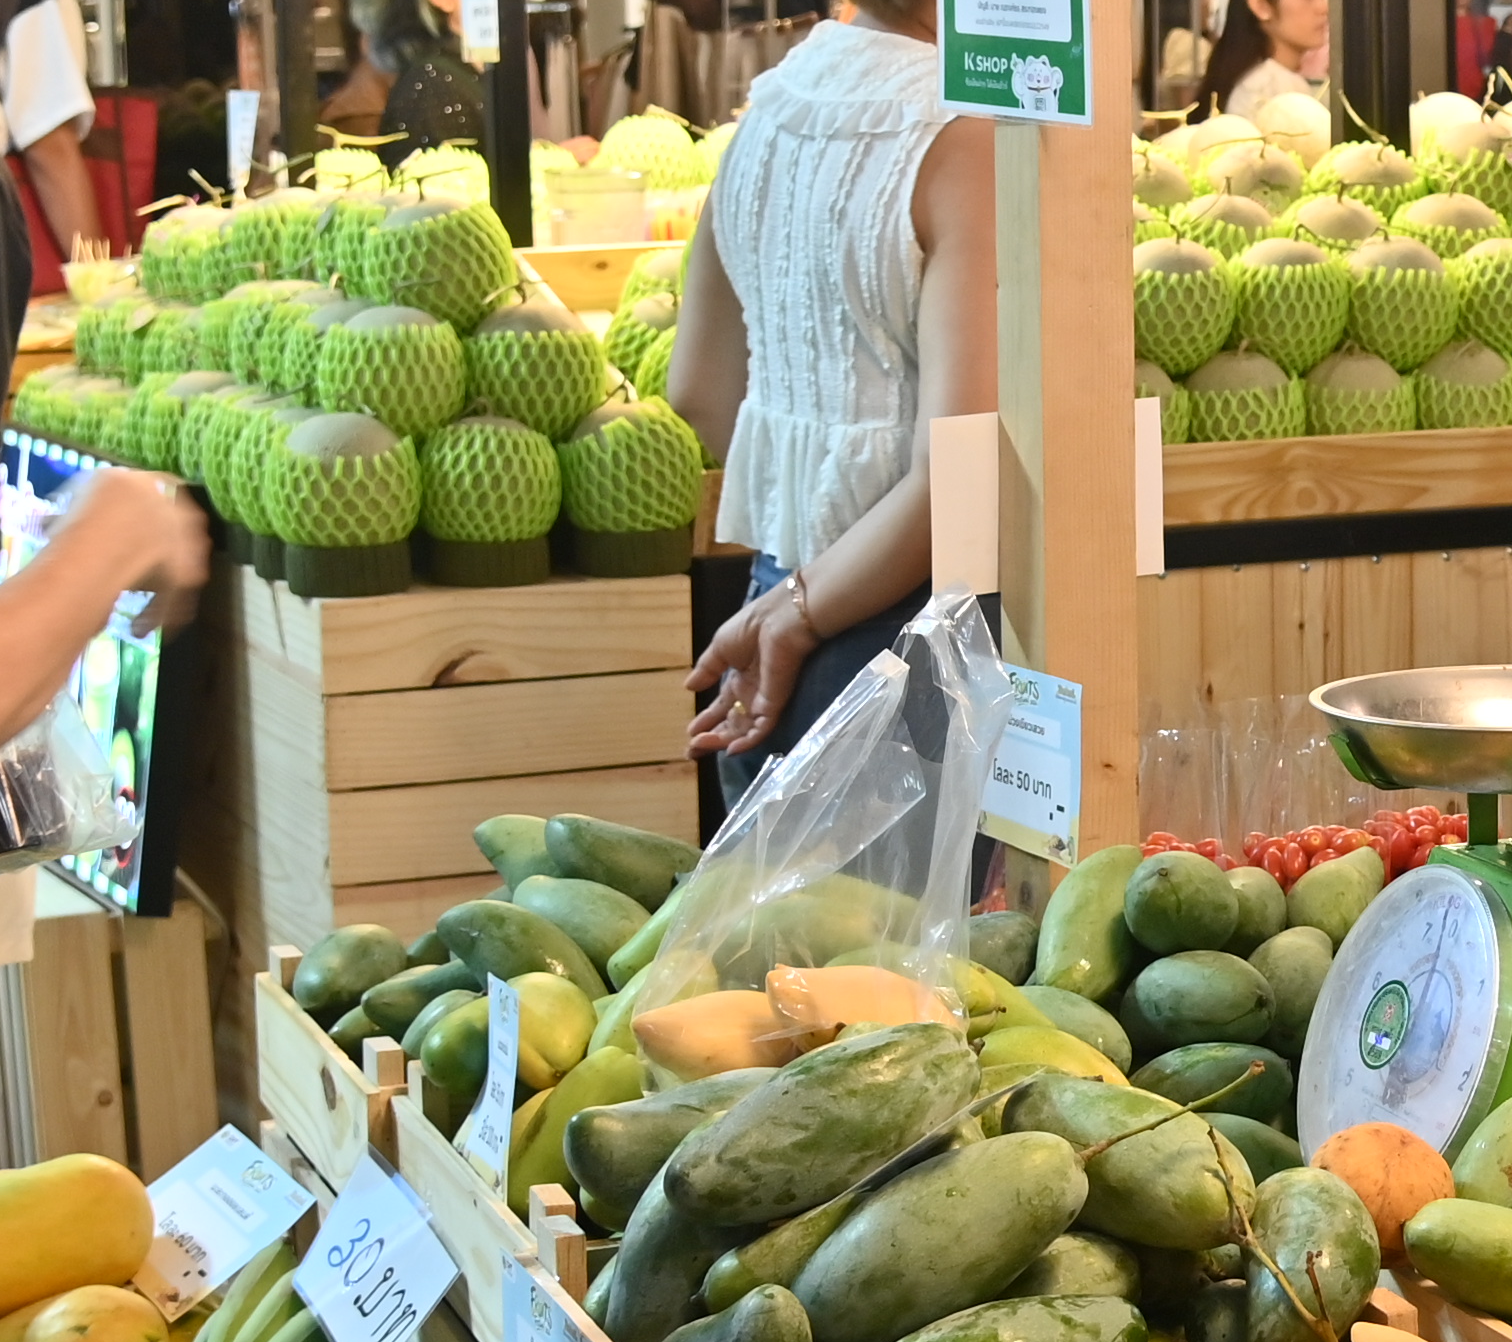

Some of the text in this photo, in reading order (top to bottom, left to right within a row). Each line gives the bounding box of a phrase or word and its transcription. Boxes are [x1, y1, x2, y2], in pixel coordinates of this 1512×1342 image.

[976, 55, 1008, 74] SHOP
[992, 757, 1052, 800] โลละ 50 บาท
